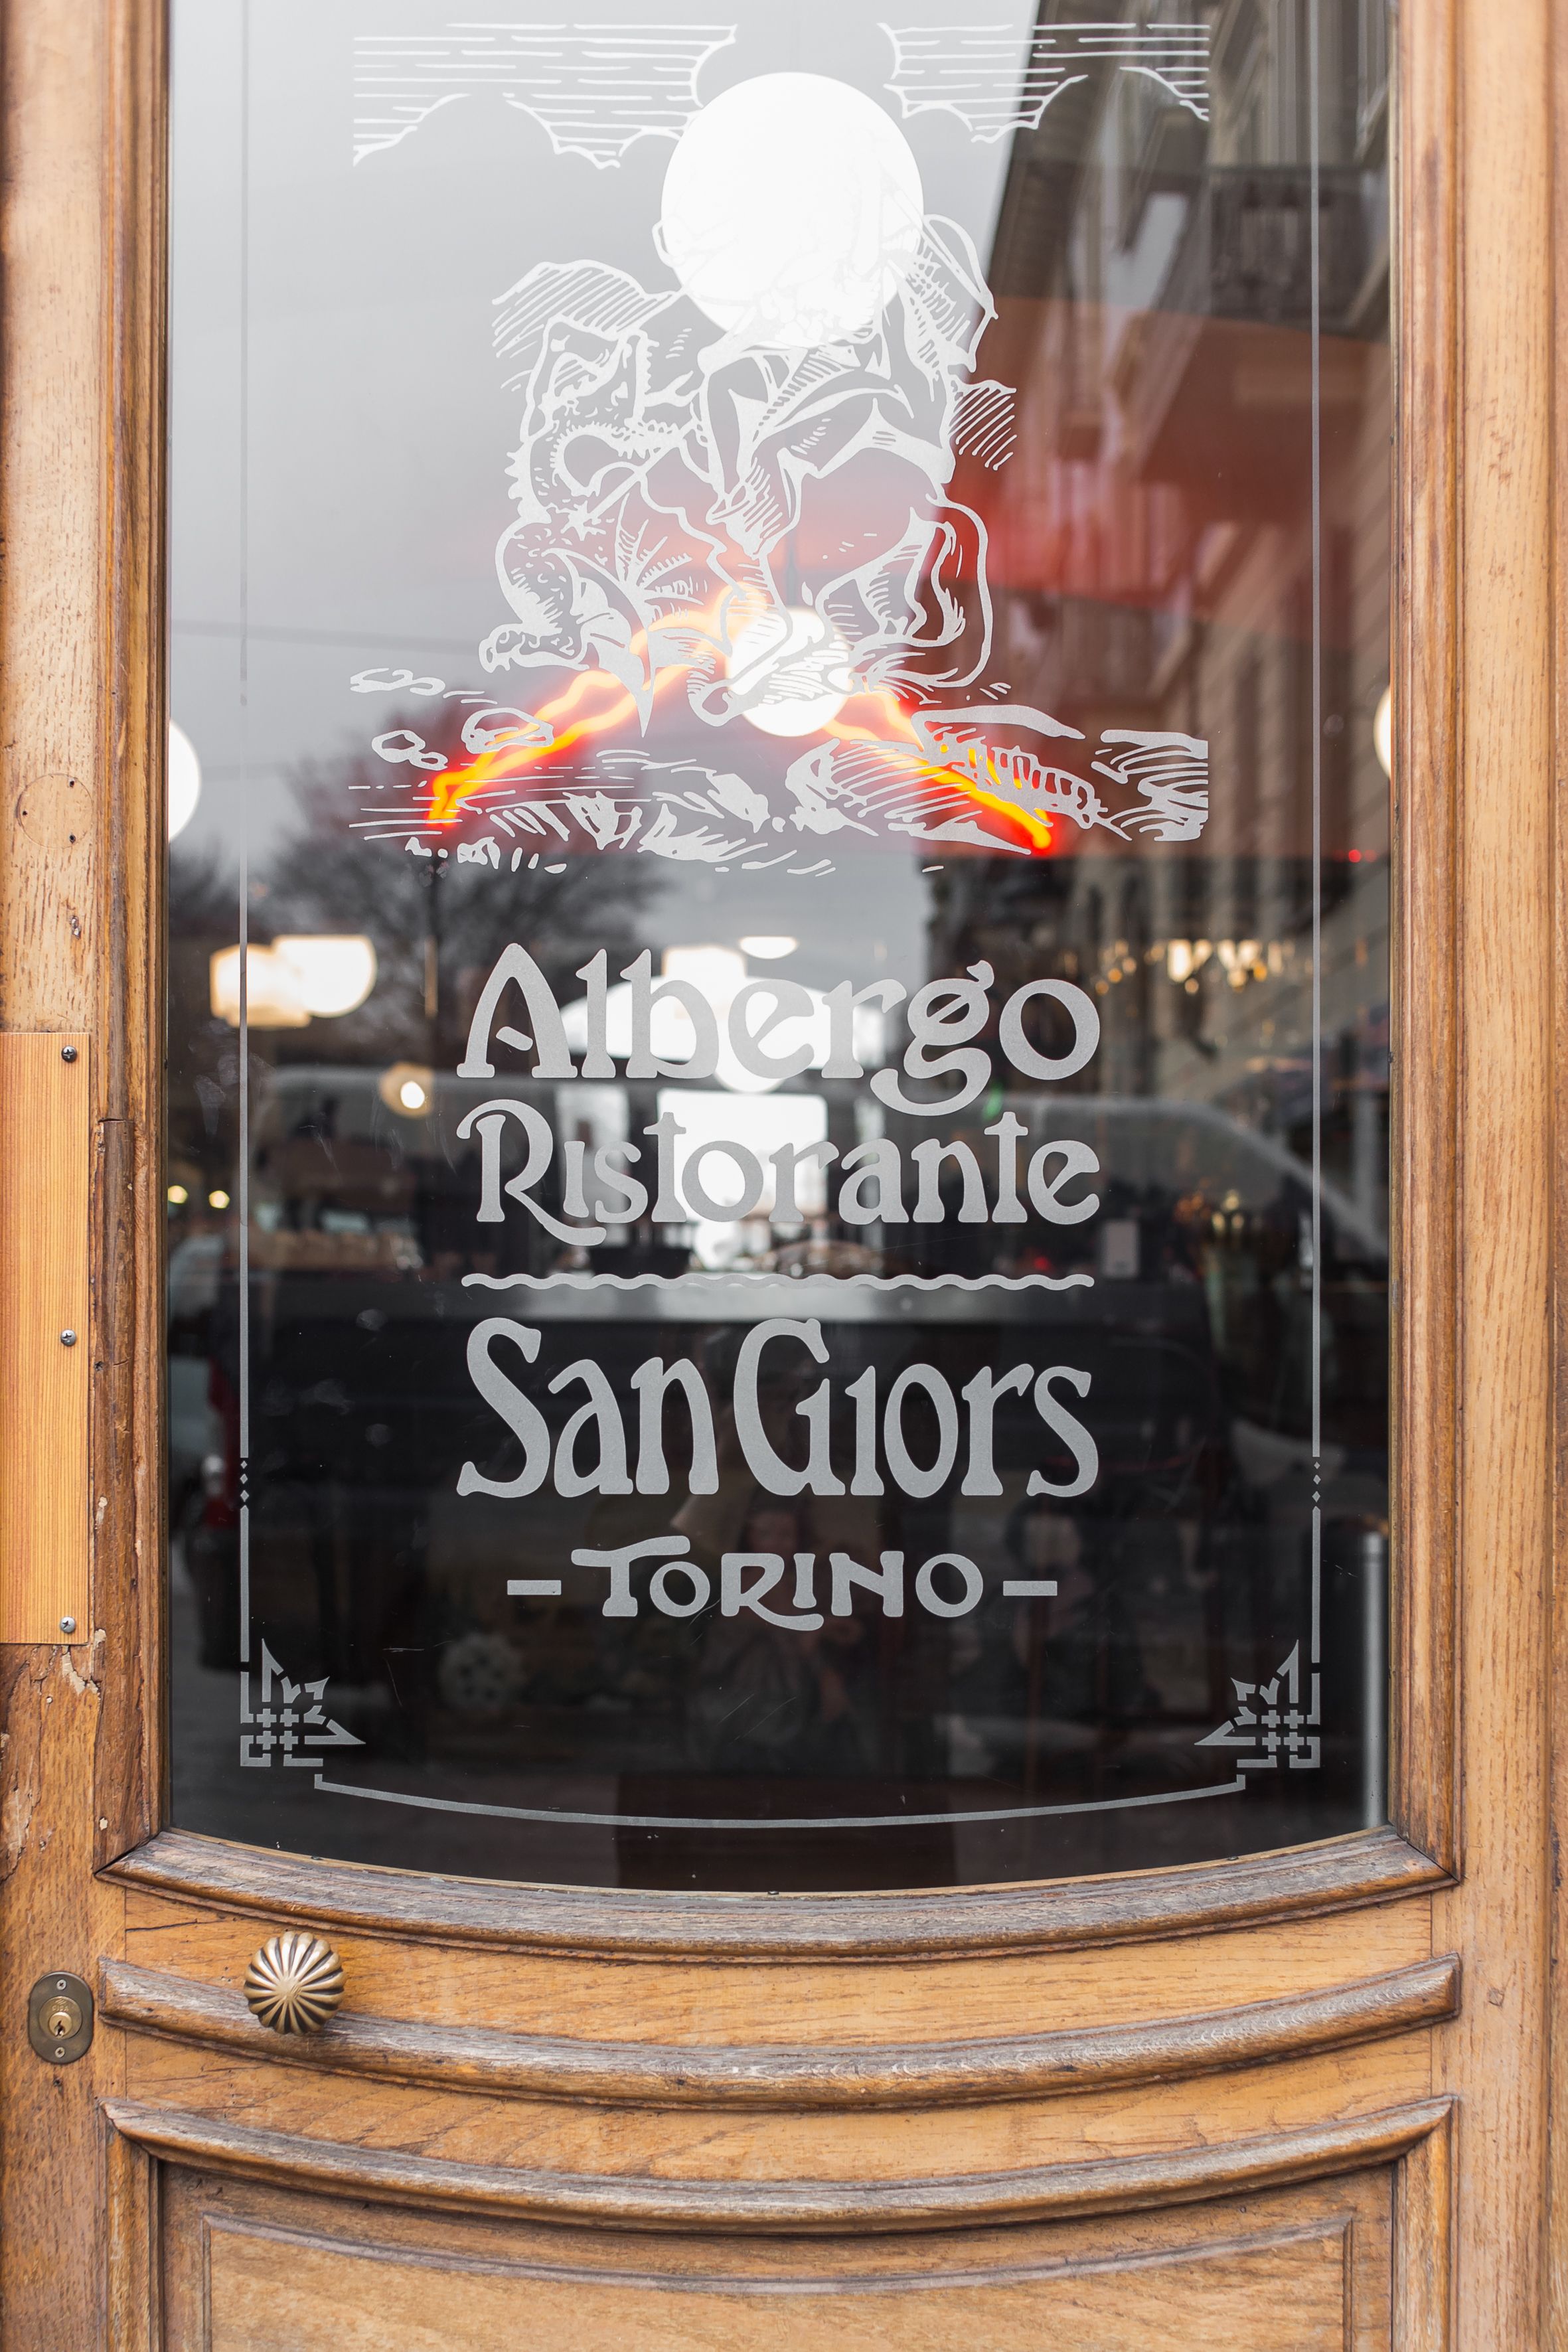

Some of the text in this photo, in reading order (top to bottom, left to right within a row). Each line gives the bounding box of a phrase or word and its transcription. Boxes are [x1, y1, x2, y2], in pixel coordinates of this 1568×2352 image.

[457, 943, 1100, 1116] Albergo
[457, 1099, 1100, 1246] Ristorante
[457, 1317, 1099, 1498] San Giors
